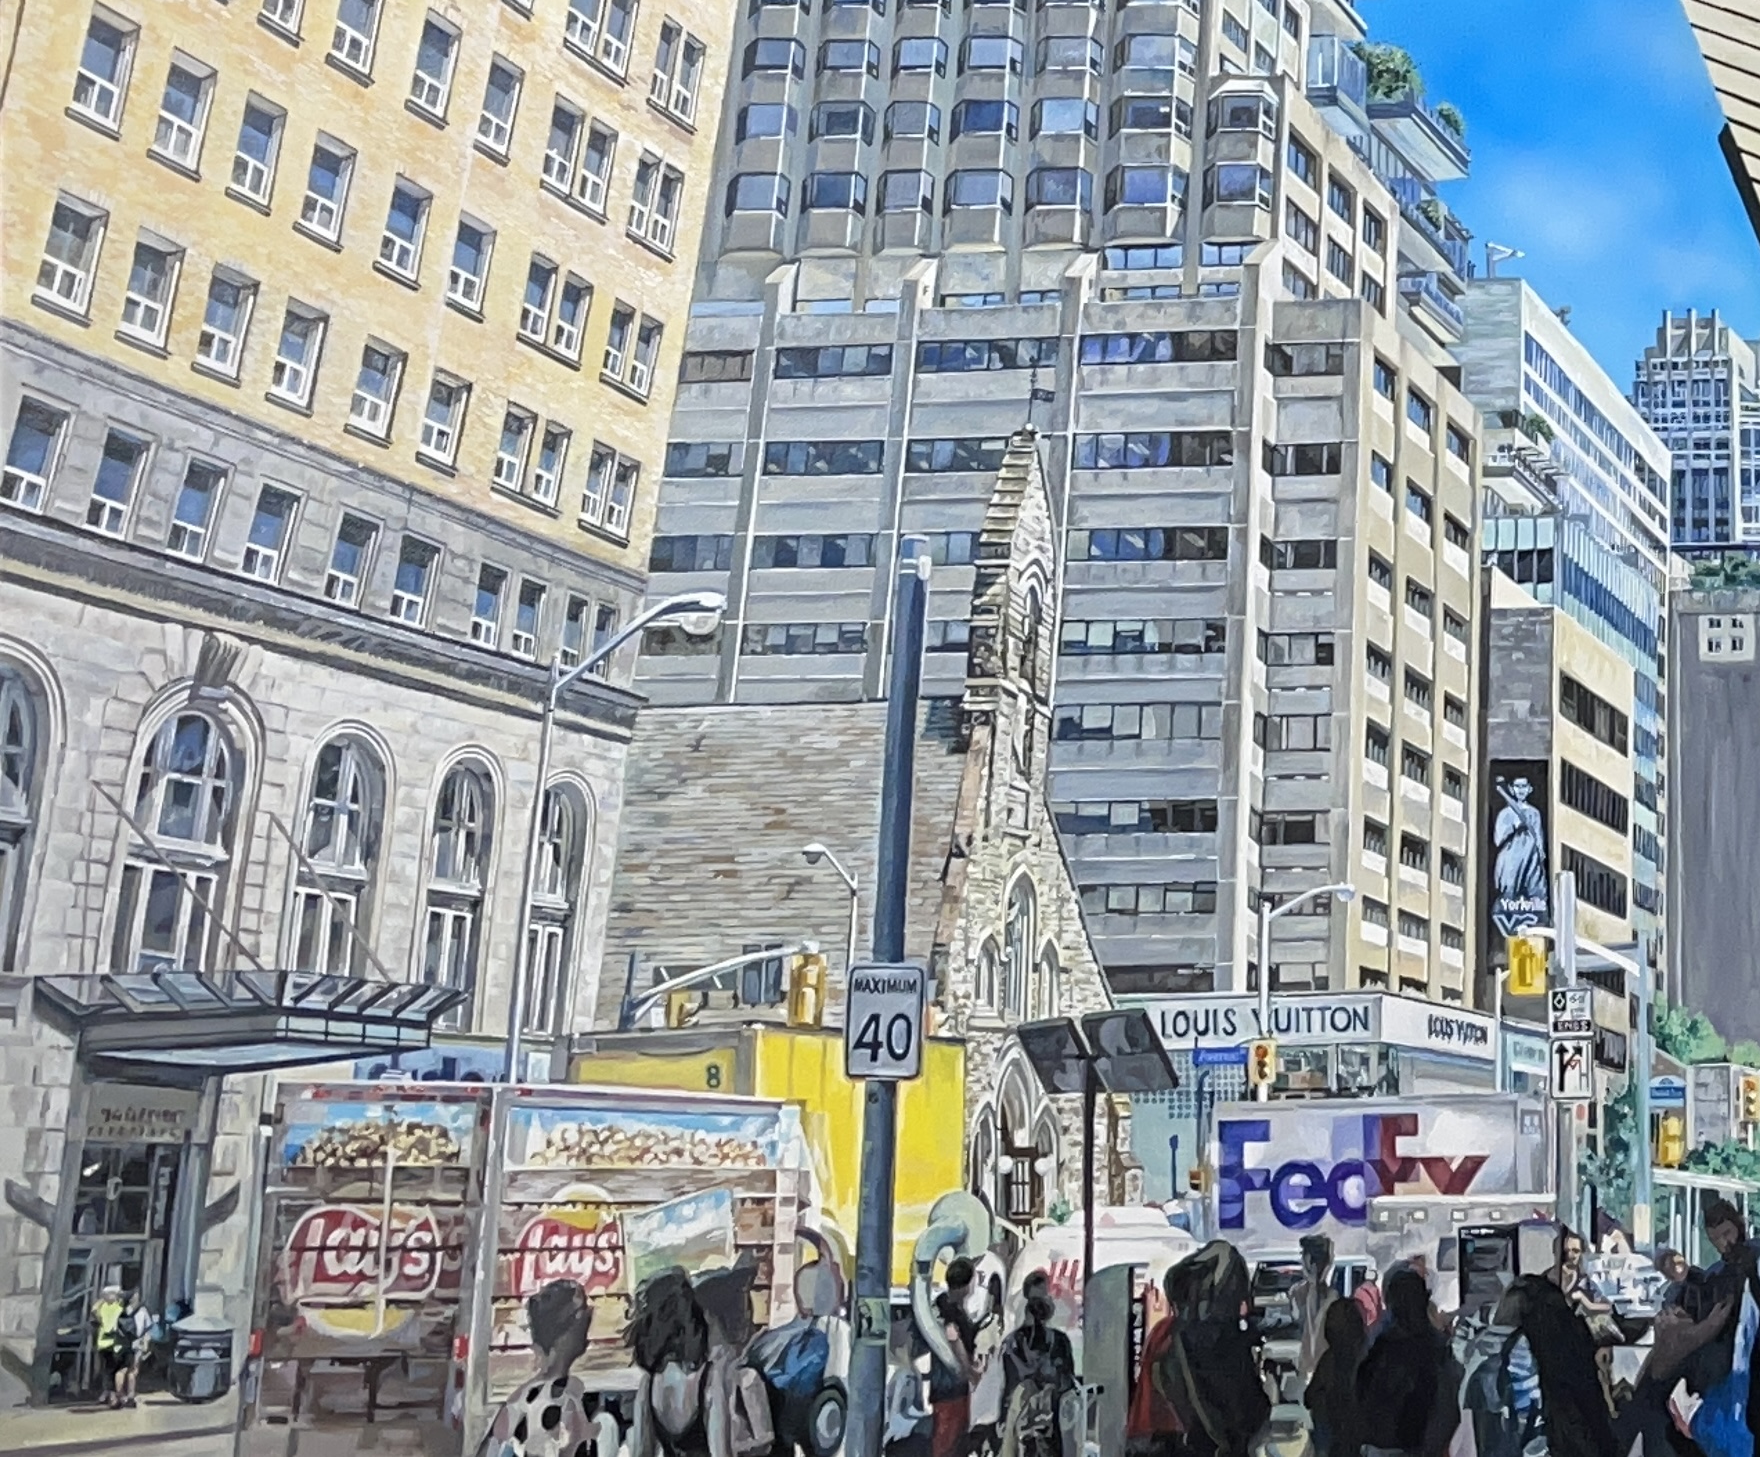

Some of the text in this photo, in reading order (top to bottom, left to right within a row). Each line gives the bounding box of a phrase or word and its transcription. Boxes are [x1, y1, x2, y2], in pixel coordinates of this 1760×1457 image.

[853, 977, 917, 994] MAXIMUM
[1160, 1008, 1237, 1039] LOUIS
[852, 1013, 913, 1063] 40
[706, 1064, 721, 1088] 8
